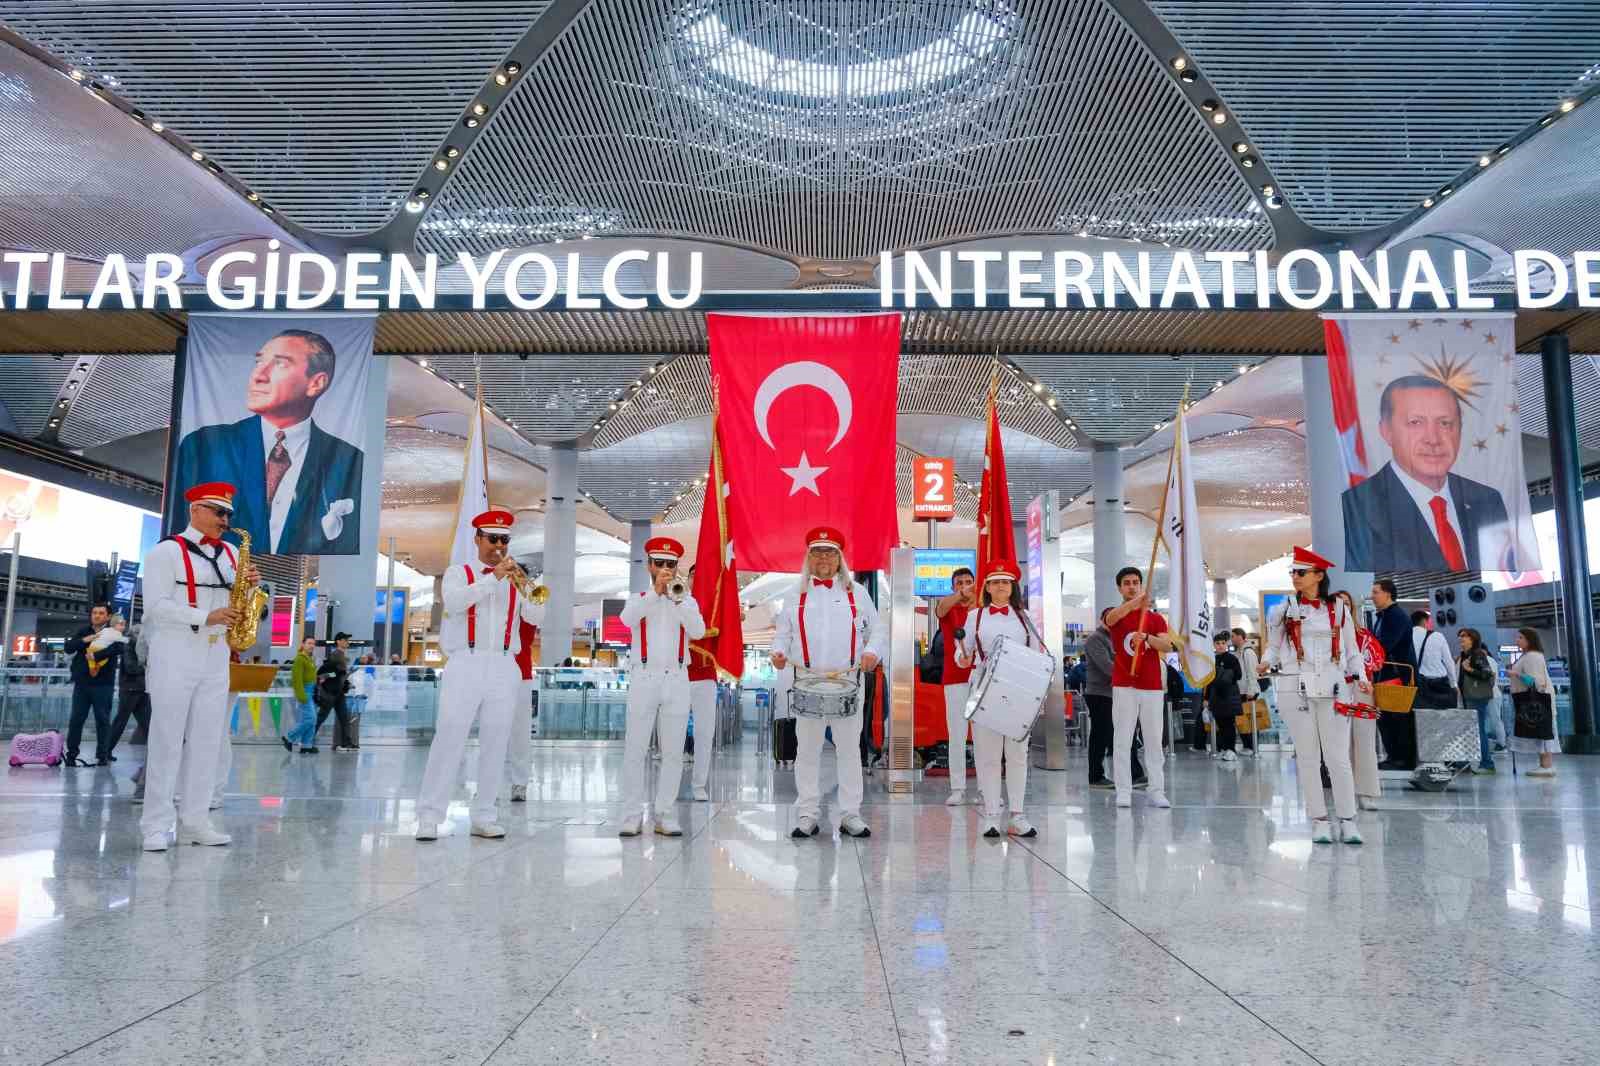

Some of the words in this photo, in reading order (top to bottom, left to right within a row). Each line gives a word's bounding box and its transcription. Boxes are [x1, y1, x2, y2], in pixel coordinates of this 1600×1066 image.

[0, 252, 184, 309] TLAR
[206, 239, 437, 310] GİDEN
[457, 248, 703, 309] YOLCU
[880, 249, 1494, 309] INTERNATIONAL
[1514, 249, 1600, 309] DE
[915, 504, 953, 512] ENTRANCE
[924, 473, 944, 501] 2
